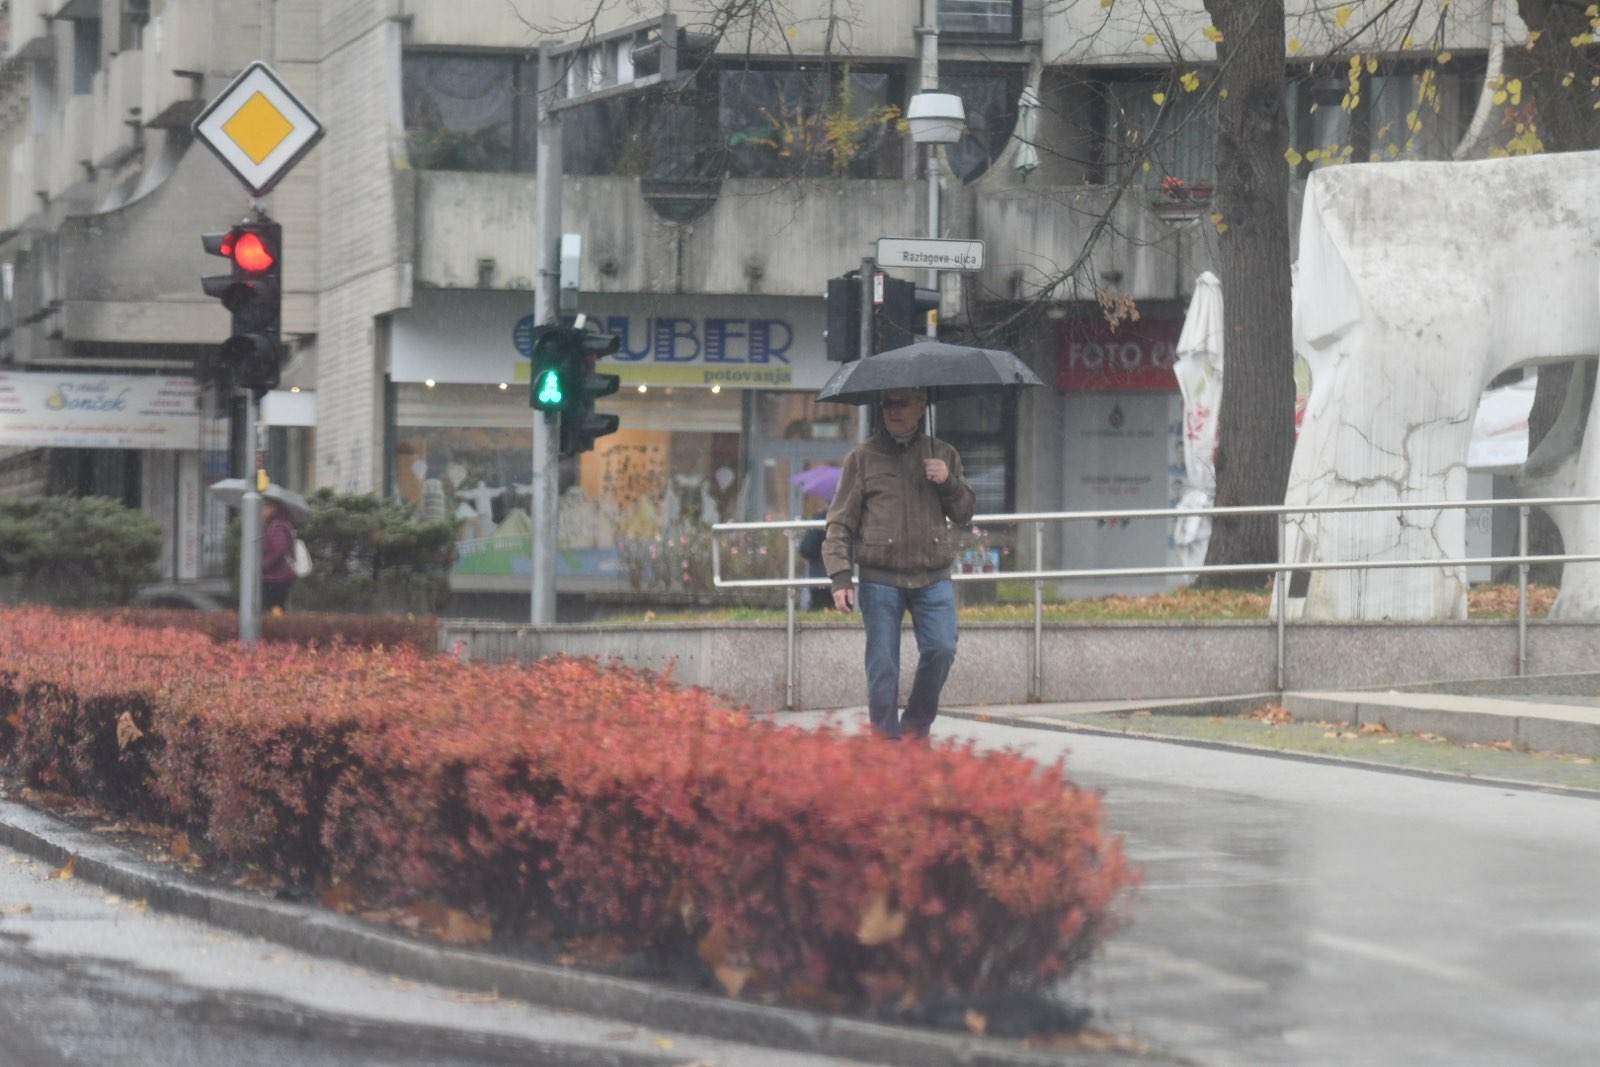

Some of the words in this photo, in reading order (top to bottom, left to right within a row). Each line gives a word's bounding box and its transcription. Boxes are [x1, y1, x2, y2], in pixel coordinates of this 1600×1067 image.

[954, 252, 976, 264] ulica
[1069, 341, 1142, 369] FOTO
[703, 368, 791, 384] potovanja
